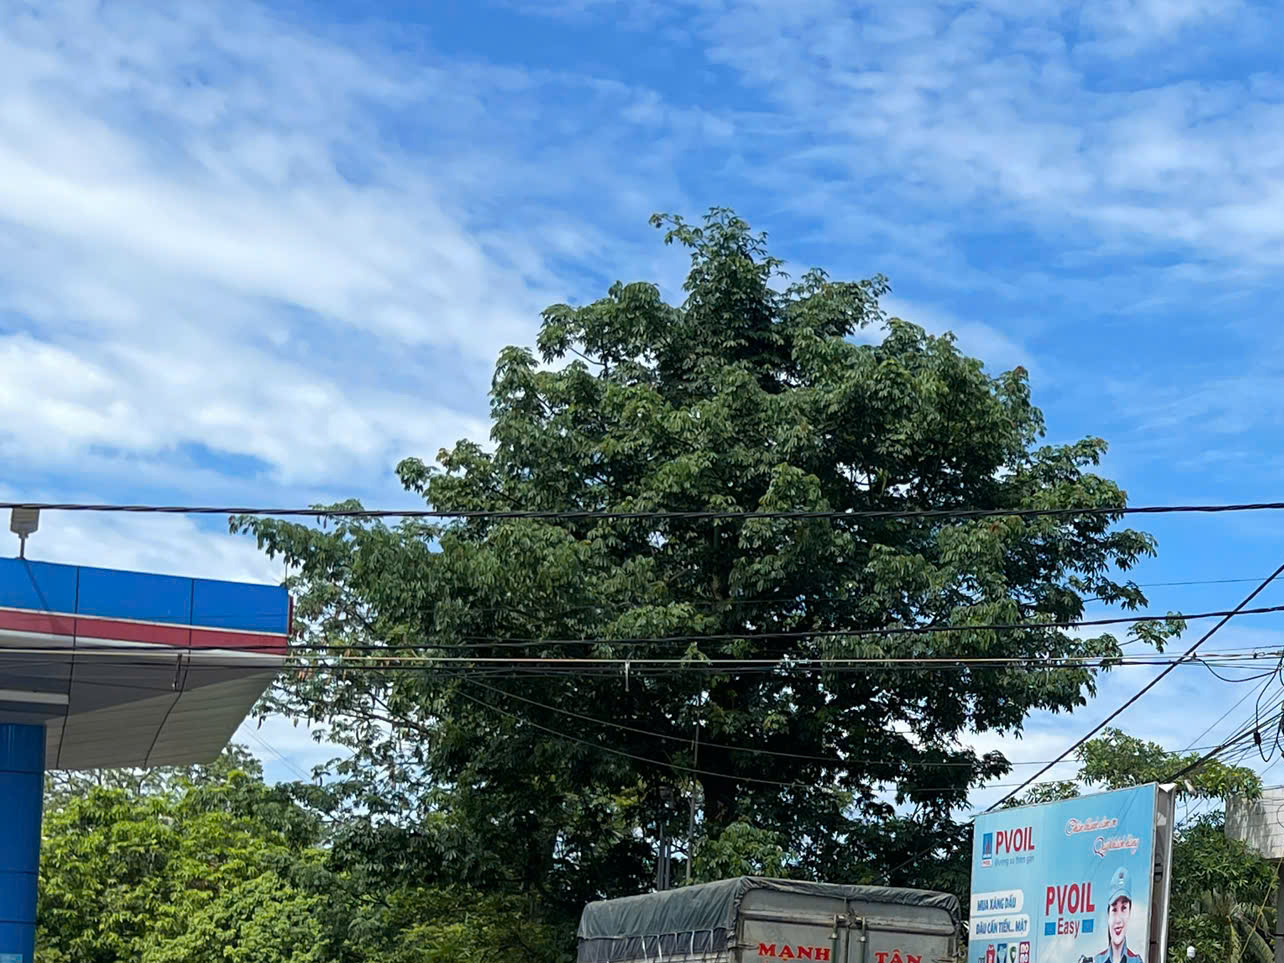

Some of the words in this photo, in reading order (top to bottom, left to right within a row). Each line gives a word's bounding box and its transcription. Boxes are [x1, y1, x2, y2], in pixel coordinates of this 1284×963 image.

[995, 827, 1035, 855] PVOIL
[1045, 882, 1096, 916] PVOIL
[1057, 917, 1081, 939] Easy
[758, 943, 830, 961] MẠNH
